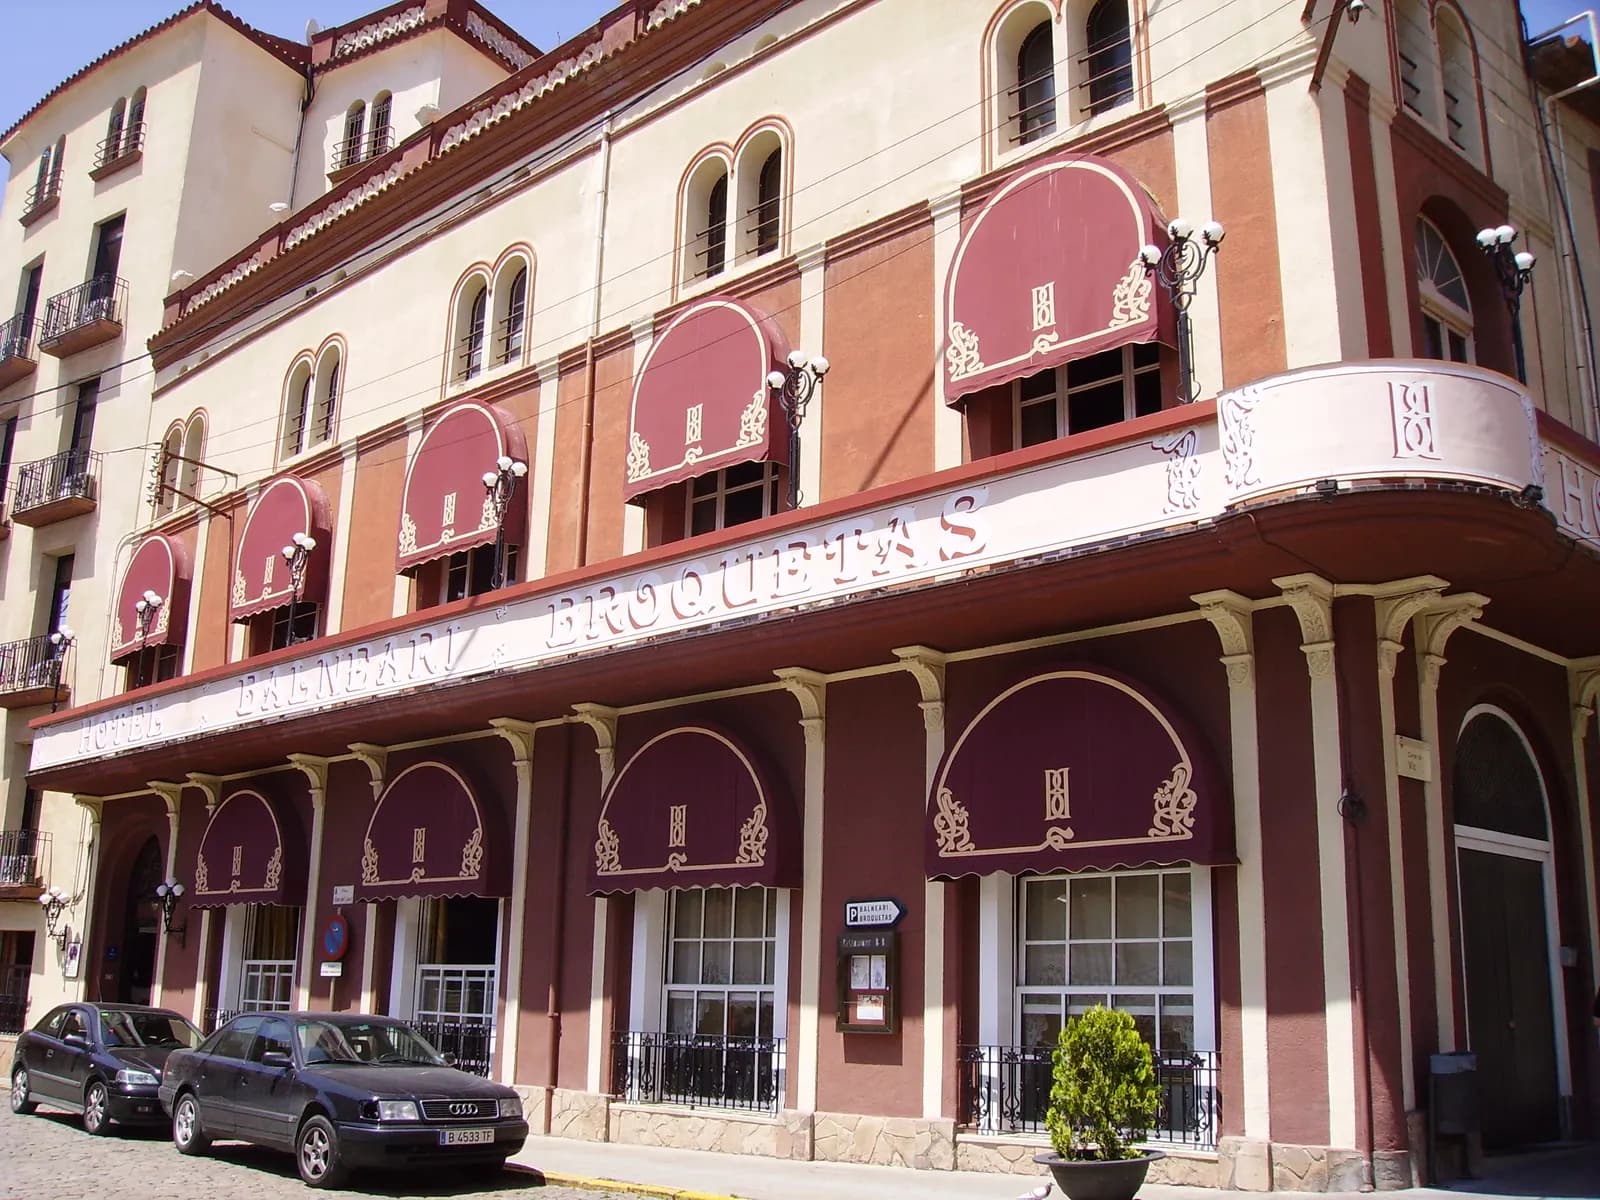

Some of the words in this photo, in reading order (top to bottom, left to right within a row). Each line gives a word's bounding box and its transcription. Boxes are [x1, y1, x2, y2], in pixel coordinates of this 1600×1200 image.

[78, 701, 163, 754] HOTEL
[236, 624, 462, 716] BALNEARI
[545, 487, 992, 648] BROQUETAS
[448, 1132, 454, 1143] B
[458, 1131, 479, 1142] 4533
